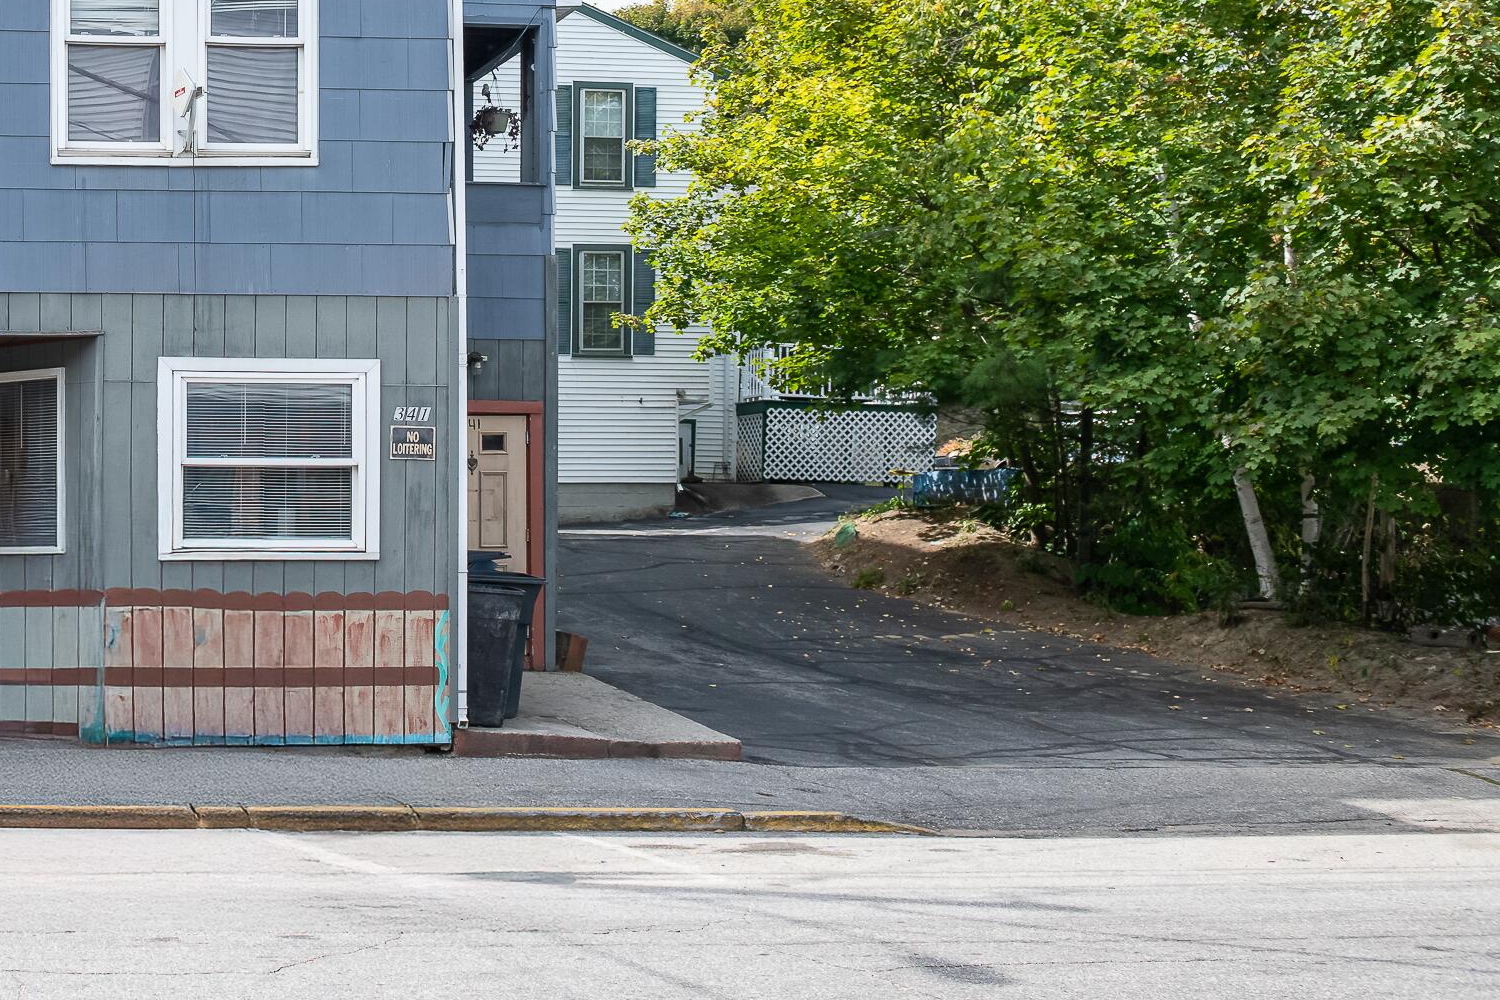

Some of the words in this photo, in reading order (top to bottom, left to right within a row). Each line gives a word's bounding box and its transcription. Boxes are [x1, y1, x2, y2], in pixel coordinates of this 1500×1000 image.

[394, 406, 429, 421] 341
[406, 431, 420, 443] NO
[392, 442, 433, 455] LOITERING
